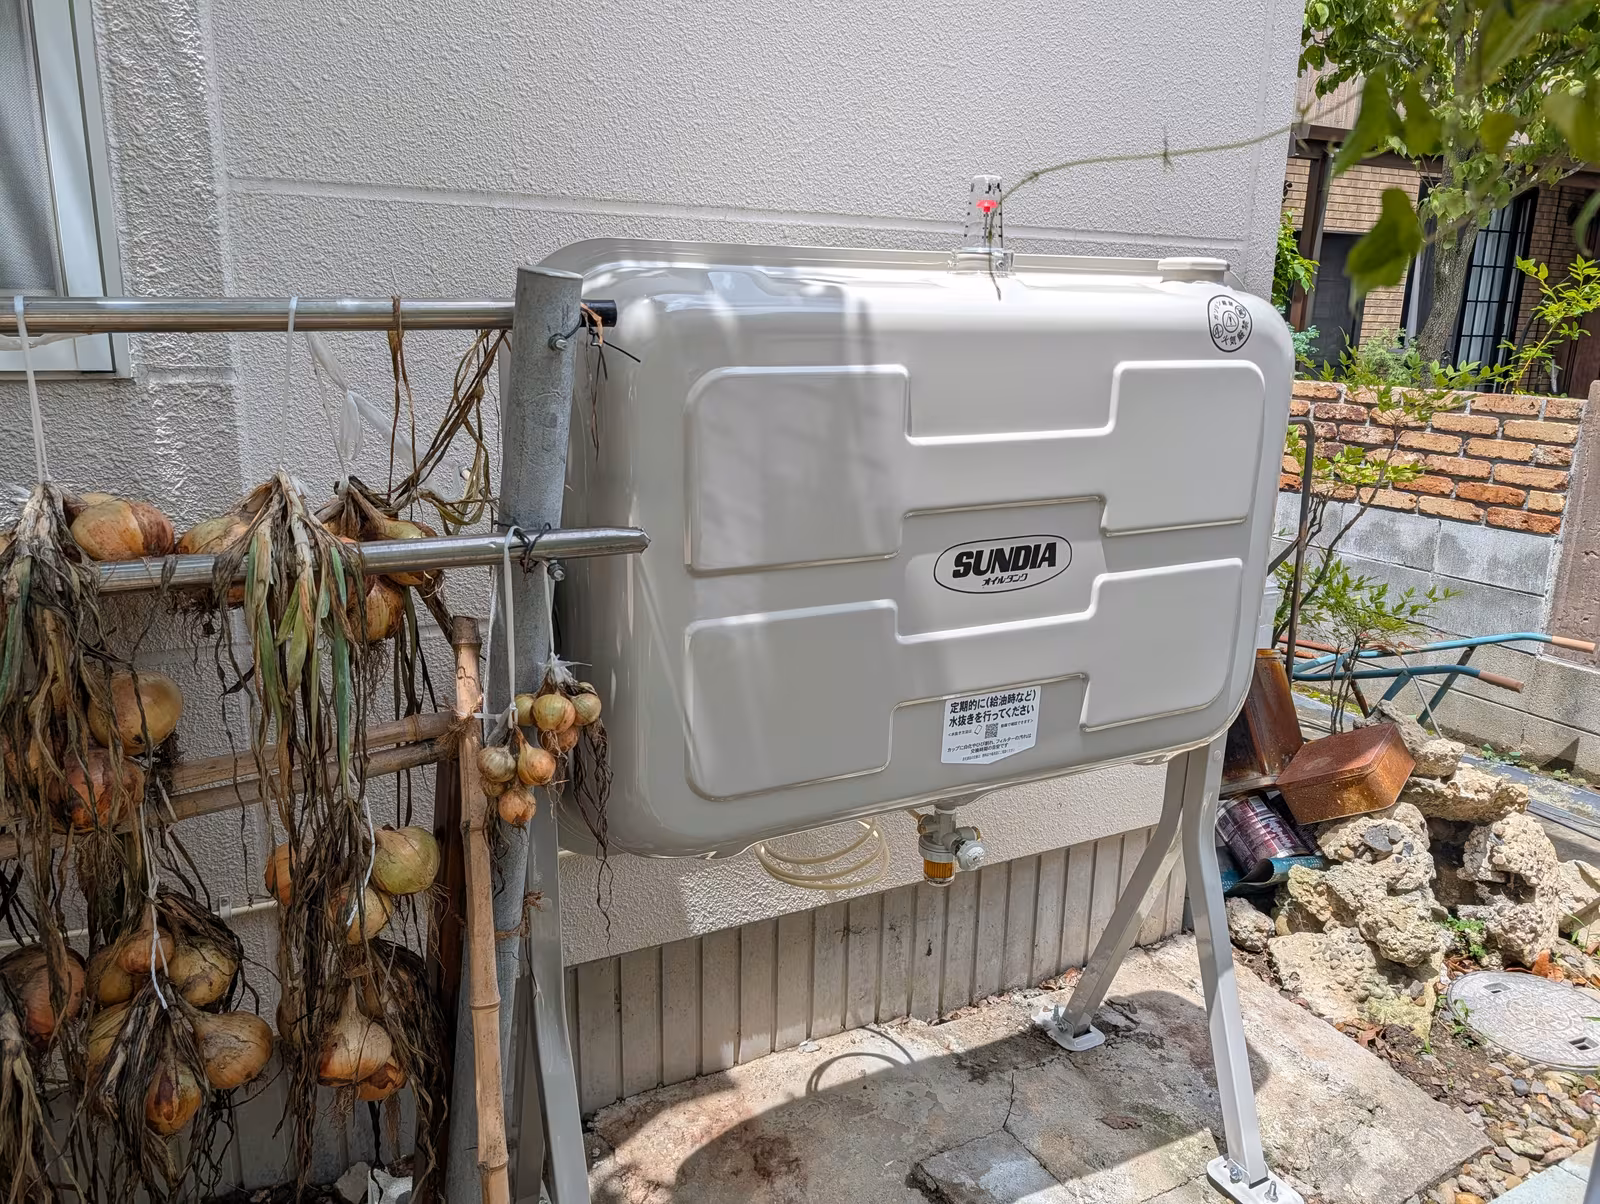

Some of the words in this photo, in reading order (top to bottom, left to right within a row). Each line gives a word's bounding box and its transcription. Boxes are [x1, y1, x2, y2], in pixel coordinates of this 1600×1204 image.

[952, 541, 1057, 578] SUNDIA
[981, 573, 1028, 586] オイルタンク
[950, 689, 1036, 714] 定期的に(給油時など)
[949, 704, 1035, 728] 水抜きを行ってください
